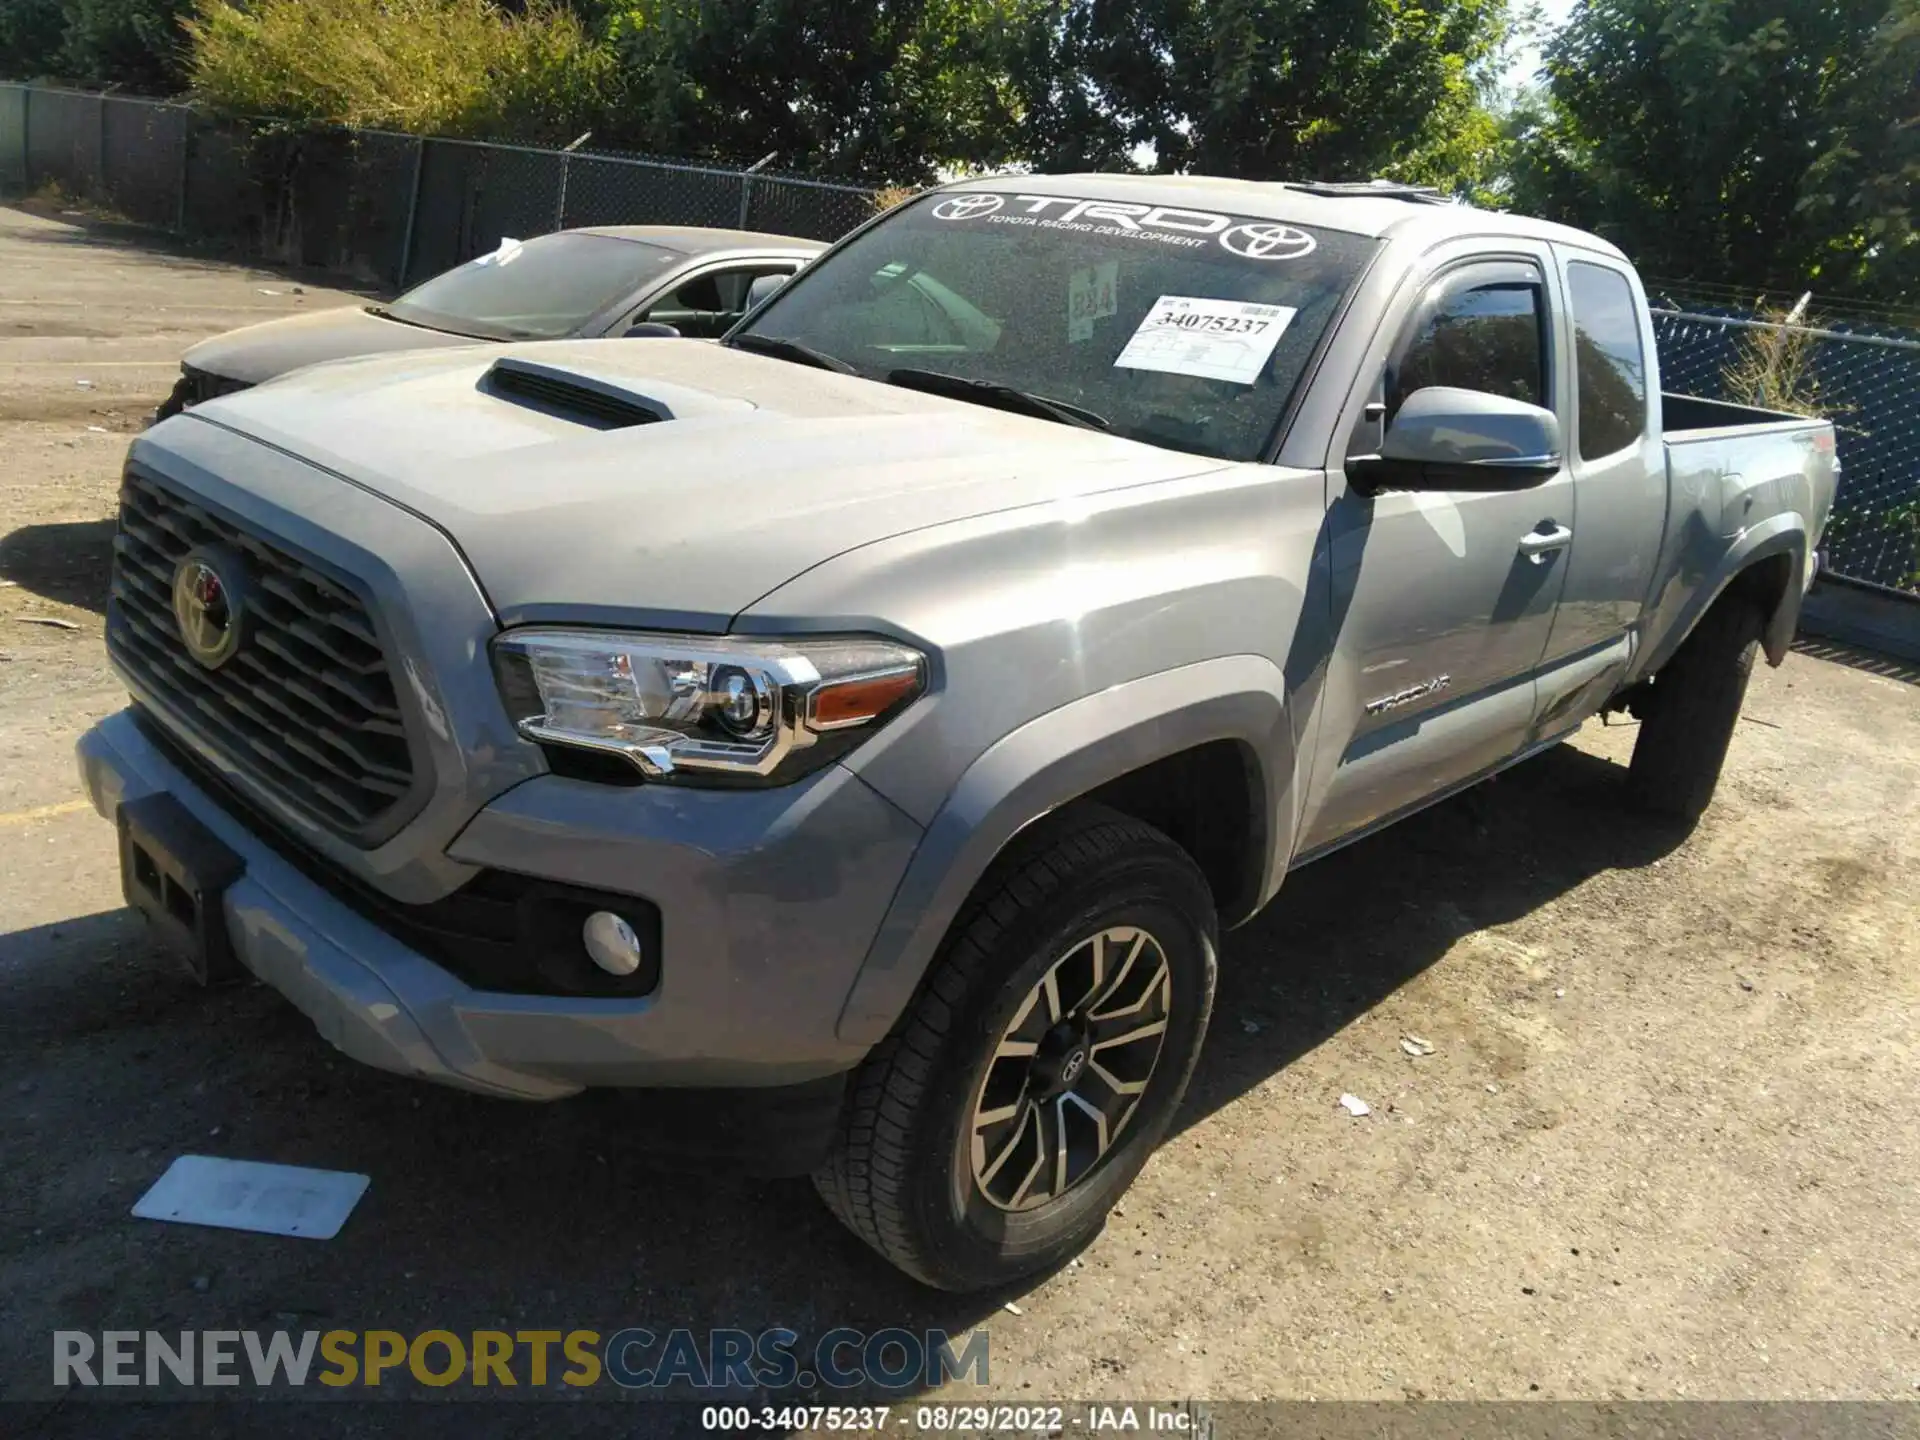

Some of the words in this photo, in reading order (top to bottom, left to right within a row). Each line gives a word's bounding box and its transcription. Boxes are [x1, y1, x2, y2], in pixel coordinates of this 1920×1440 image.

[987, 214, 1037, 226] TOYOTA
[1041, 218, 1093, 232] RACING
[1093, 224, 1208, 248] DEVELOPMENT
[1014, 195, 1232, 234] TRD
[1157, 312, 1270, 335] 34075237
